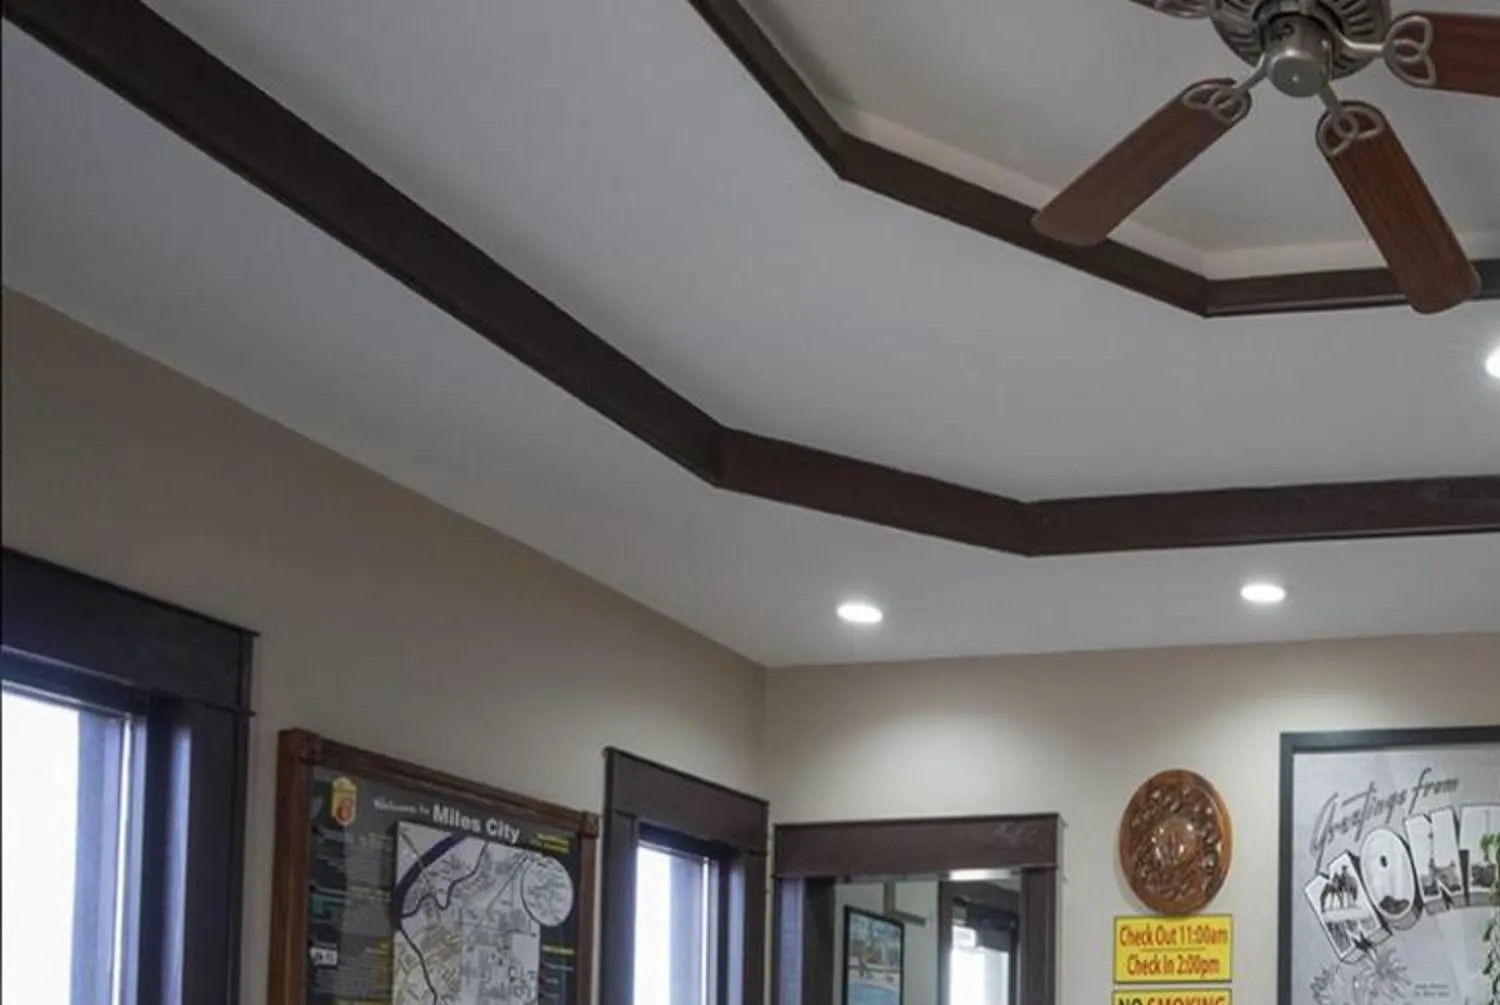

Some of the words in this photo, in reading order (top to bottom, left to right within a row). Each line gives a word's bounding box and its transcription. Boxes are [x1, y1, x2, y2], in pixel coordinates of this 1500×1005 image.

[1408, 767, 1459, 816] from
[433, 804, 482, 833] Miles
[485, 818, 521, 845] City
[1120, 923, 1153, 947] Check
[1155, 925, 1177, 946] Out
[1179, 924, 1229, 945] 11:00am
[1127, 954, 1161, 976] Check
[1163, 955, 1175, 975] In
[1176, 954, 1220, 978] 2:00pm
